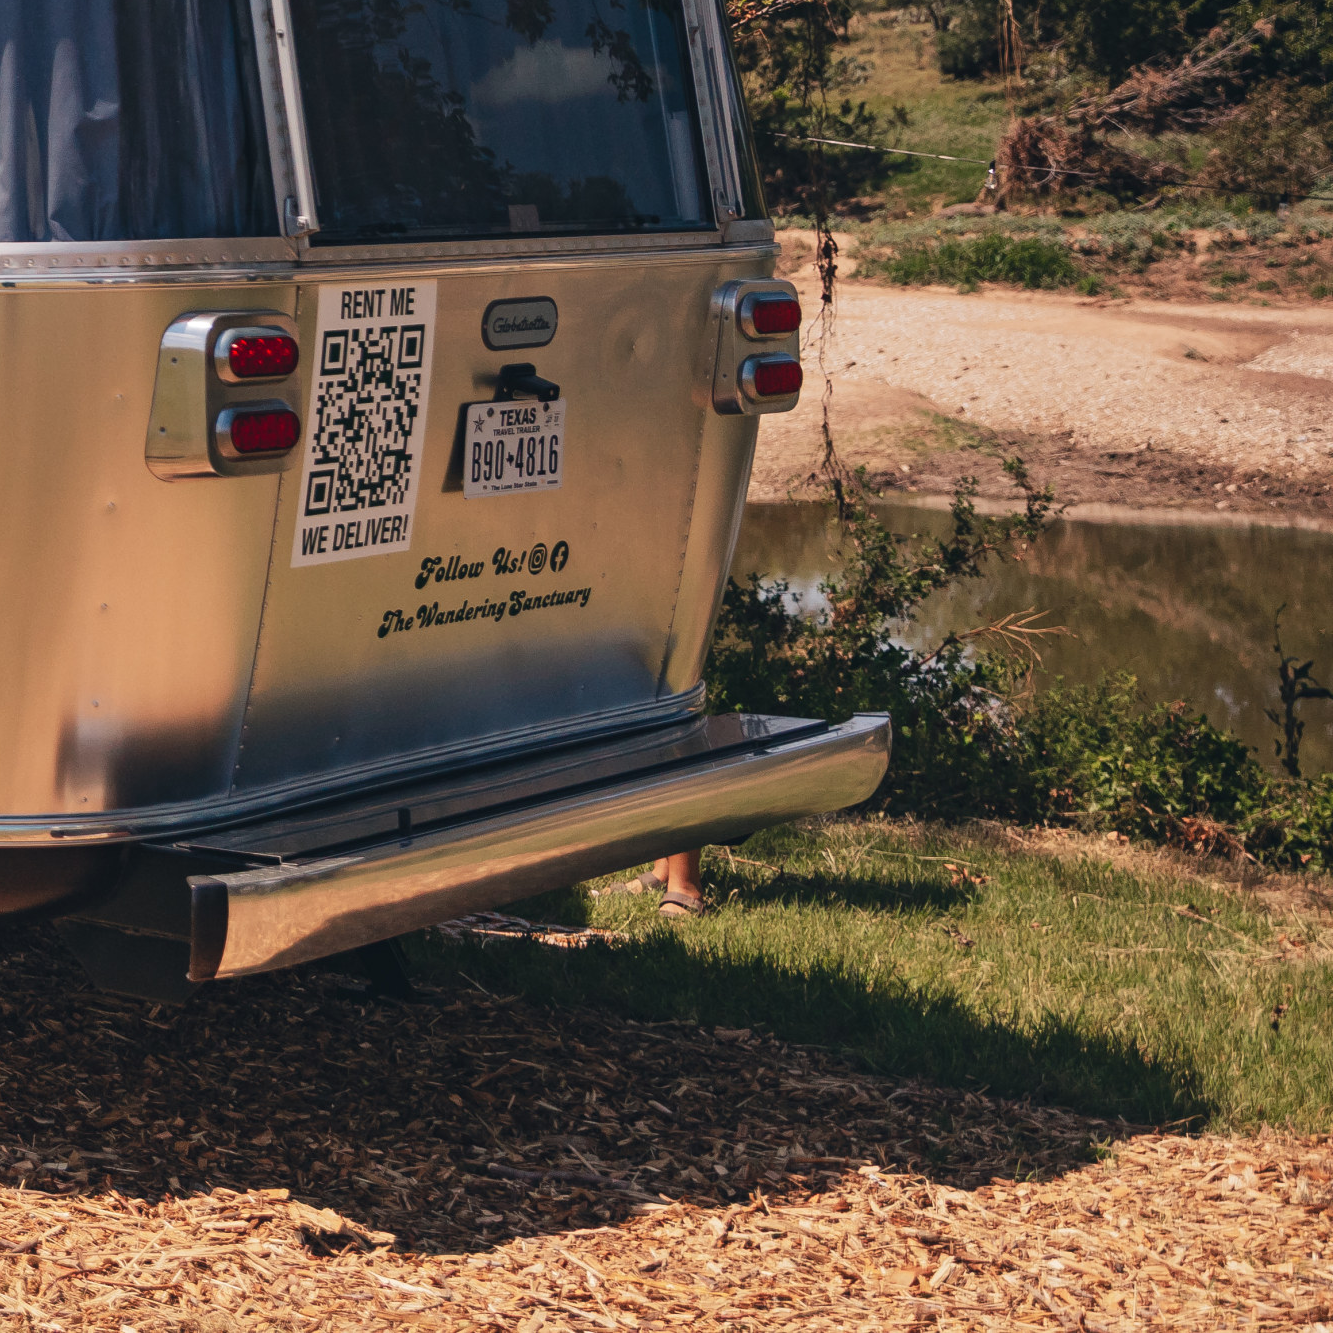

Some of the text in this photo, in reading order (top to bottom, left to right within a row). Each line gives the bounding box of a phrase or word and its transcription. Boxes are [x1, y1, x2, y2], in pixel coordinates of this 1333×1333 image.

[341, 287, 416, 319] RENT ME
[493, 425, 541, 436] TRAVEL TRAILER
[500, 407, 537, 426] TEXAS
[302, 514, 409, 556] WE DELIVER!
[415, 547, 527, 589] Follow Us!
[377, 587, 592, 638] The Wandering Sanctuary
